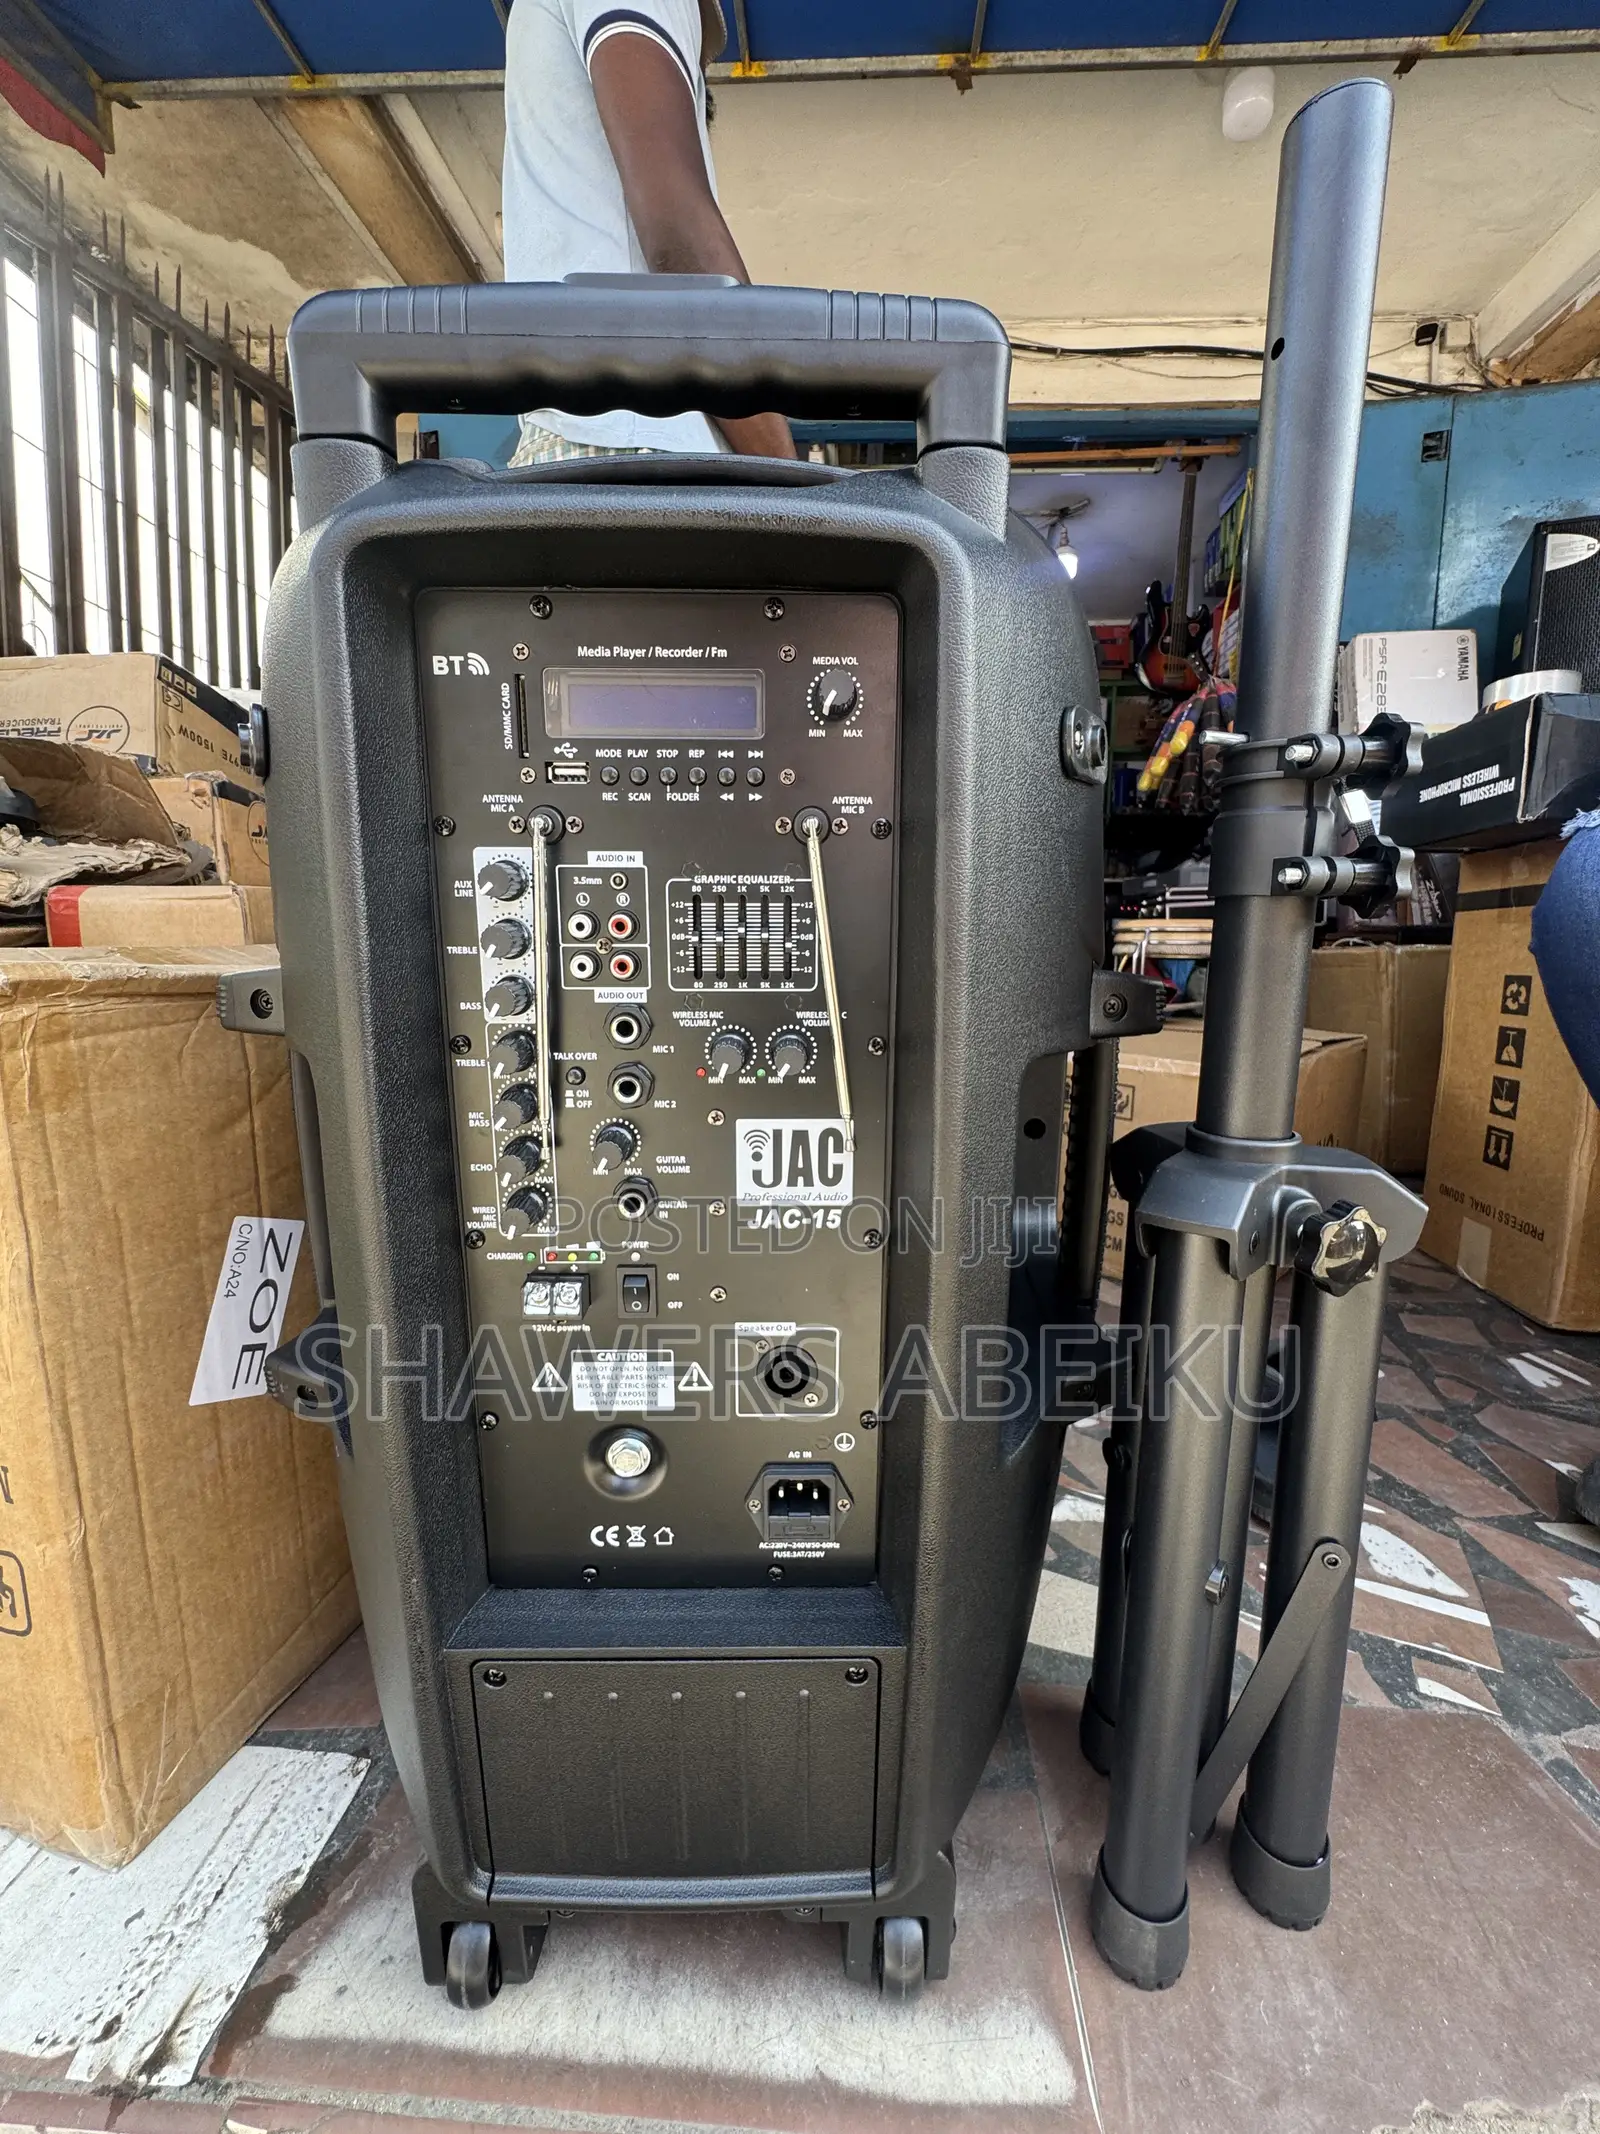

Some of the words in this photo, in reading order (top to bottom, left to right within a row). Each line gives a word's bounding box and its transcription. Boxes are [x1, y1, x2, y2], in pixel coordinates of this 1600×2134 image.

[577, 645, 611, 658] Media
[613, 645, 646, 660] Player
[655, 646, 704, 658] Recorder
[712, 647, 728, 658] Fm
[812, 656, 840, 665] MEDIA
[840, 656, 859, 665] VOL
[1456, 646, 1469, 681] YAMAHA
[432, 655, 464, 676] BT
[500, 682, 512, 710] CARD
[502, 710, 513, 750] SD/MMC
[808, 729, 826, 738] MIN
[843, 729, 863, 738] MAX
[178, 724, 215, 753] 1500W
[595, 749, 622, 758] MODE
[627, 749, 649, 758] PLAY
[656, 750, 678, 758] STOP
[688, 750, 705, 758] REP
[1462, 764, 1500, 788] WIRELESS
[1419, 776, 1462, 803] MICROPHONE
[1460, 777, 1516, 806] PROFESSIONAL
[482, 794, 524, 804] ANTENNA
[602, 792, 618, 802] REC
[628, 792, 651, 802] SCAN
[666, 792, 700, 802] FOLDER
[832, 796, 873, 805] ANTENNA
[490, 804, 507, 812] MIC
[508, 804, 515, 812] A
[841, 806, 858, 814] MIC
[858, 806, 865, 814] B
[596, 854, 624, 862] AUDIO
[626, 854, 636, 862] IN
[454, 880, 472, 889] AUX
[573, 876, 602, 885] 3.5mm
[694, 875, 737, 885] GRAPHIC
[738, 875, 790, 885] EQUALIZER
[454, 889, 474, 898] LINE
[447, 946, 478, 954] TREBLE
[598, 992, 624, 1000] AUDIO
[626, 992, 644, 1000] OUT
[460, 1002, 482, 1010] BASS
[672, 1010, 708, 1019] WIRELESS
[709, 1010, 724, 1019] MIC
[679, 1019, 710, 1027] VOLUME
[710, 1019, 718, 1027] A
[652, 1045, 668, 1054] MIC
[554, 1052, 575, 1060] TALK
[576, 1052, 598, 1060] OVER
[456, 1059, 486, 1067] TREBLE
[708, 1076, 724, 1084] MIN
[738, 1076, 756, 1084] MAX
[768, 1076, 784, 1084] MIN
[798, 1076, 816, 1084] MAX
[576, 1090, 590, 1098] ON
[576, 1100, 592, 1108] OFF
[654, 1100, 670, 1108] MIC
[468, 1112, 484, 1120] MIC
[468, 1120, 490, 1128] BASS
[656, 1156, 686, 1164] GUITAR
[470, 1164, 493, 1172] ECHO
[592, 1168, 608, 1176] MIN
[624, 1168, 642, 1176] MAX
[656, 1166, 690, 1174] VOLUME
[534, 1176, 554, 1184] MAX
[742, 1192, 811, 1202] Professional
[812, 1192, 848, 1201] Audio
[1439, 1183, 1466, 1204] SOUND
[658, 1201, 688, 1209] GUITAR
[472, 1206, 496, 1214] WIRED
[482, 1214, 496, 1222] MIC
[659, 1211, 668, 1219] IN
[748, 1208, 842, 1229] JAC-15
[1469, 1196, 1545, 1242] PROFESSIONAL
[537, 1226, 556, 1234] MAX
[622, 1241, 649, 1249] POWER
[224, 1223, 252, 1299] C/NO:A24
[486, 1252, 524, 1261] CHARGING
[666, 1273, 680, 1281] ON
[232, 1227, 293, 1390] ZOE
[532, 1324, 556, 1332] 12Vdc
[556, 1325, 581, 1333] power
[582, 1324, 590, 1332] in
[738, 1324, 774, 1333] Speaker
[776, 1324, 792, 1332] Out
[597, 1352, 647, 1362] CAUTION
